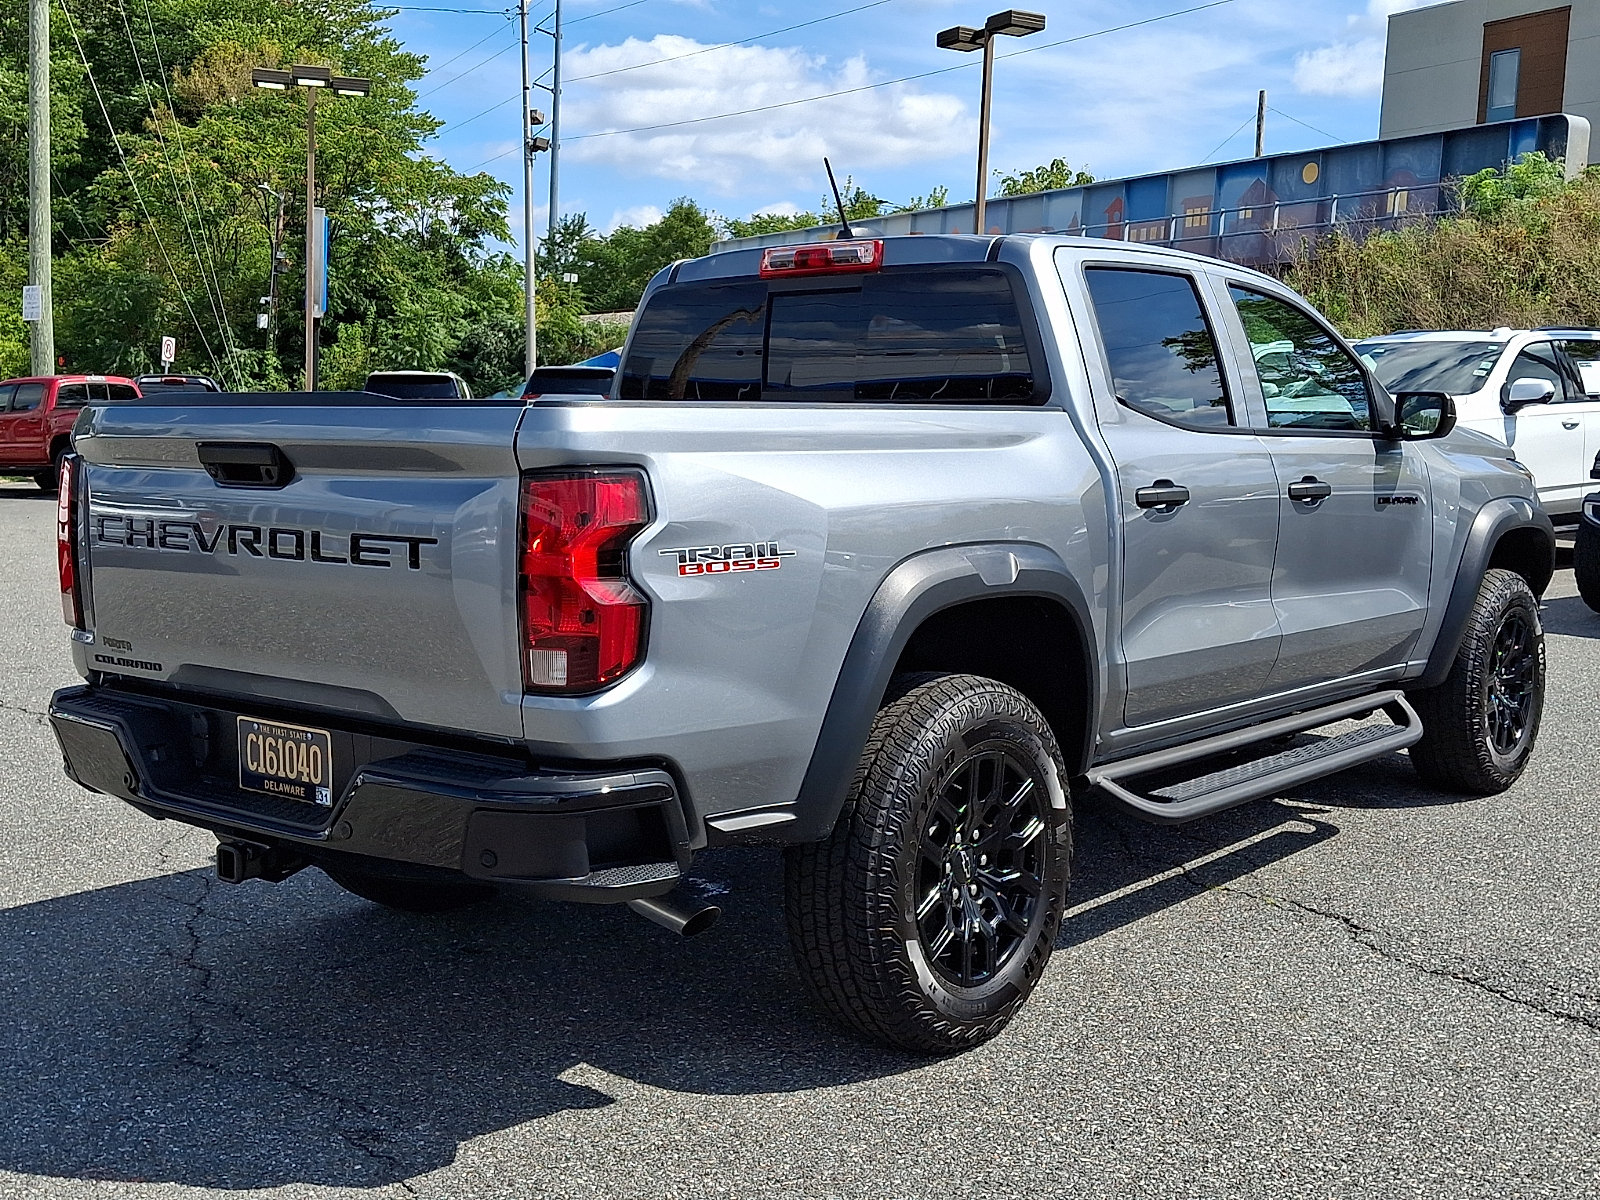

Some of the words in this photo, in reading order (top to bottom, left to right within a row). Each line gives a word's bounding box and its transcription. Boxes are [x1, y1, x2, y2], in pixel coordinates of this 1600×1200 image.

[96, 515, 439, 570] CHEVROLET
[658, 540, 797, 563] TRAIL
[678, 557, 781, 577] BOSS
[94, 654, 162, 671] COLORADO
[260, 726, 270, 734] THE
[272, 728, 287, 737] FIRST
[289, 731, 307, 740] STATE
[247, 733, 322, 784] C161040
[264, 780, 305, 796] DELAWARE
